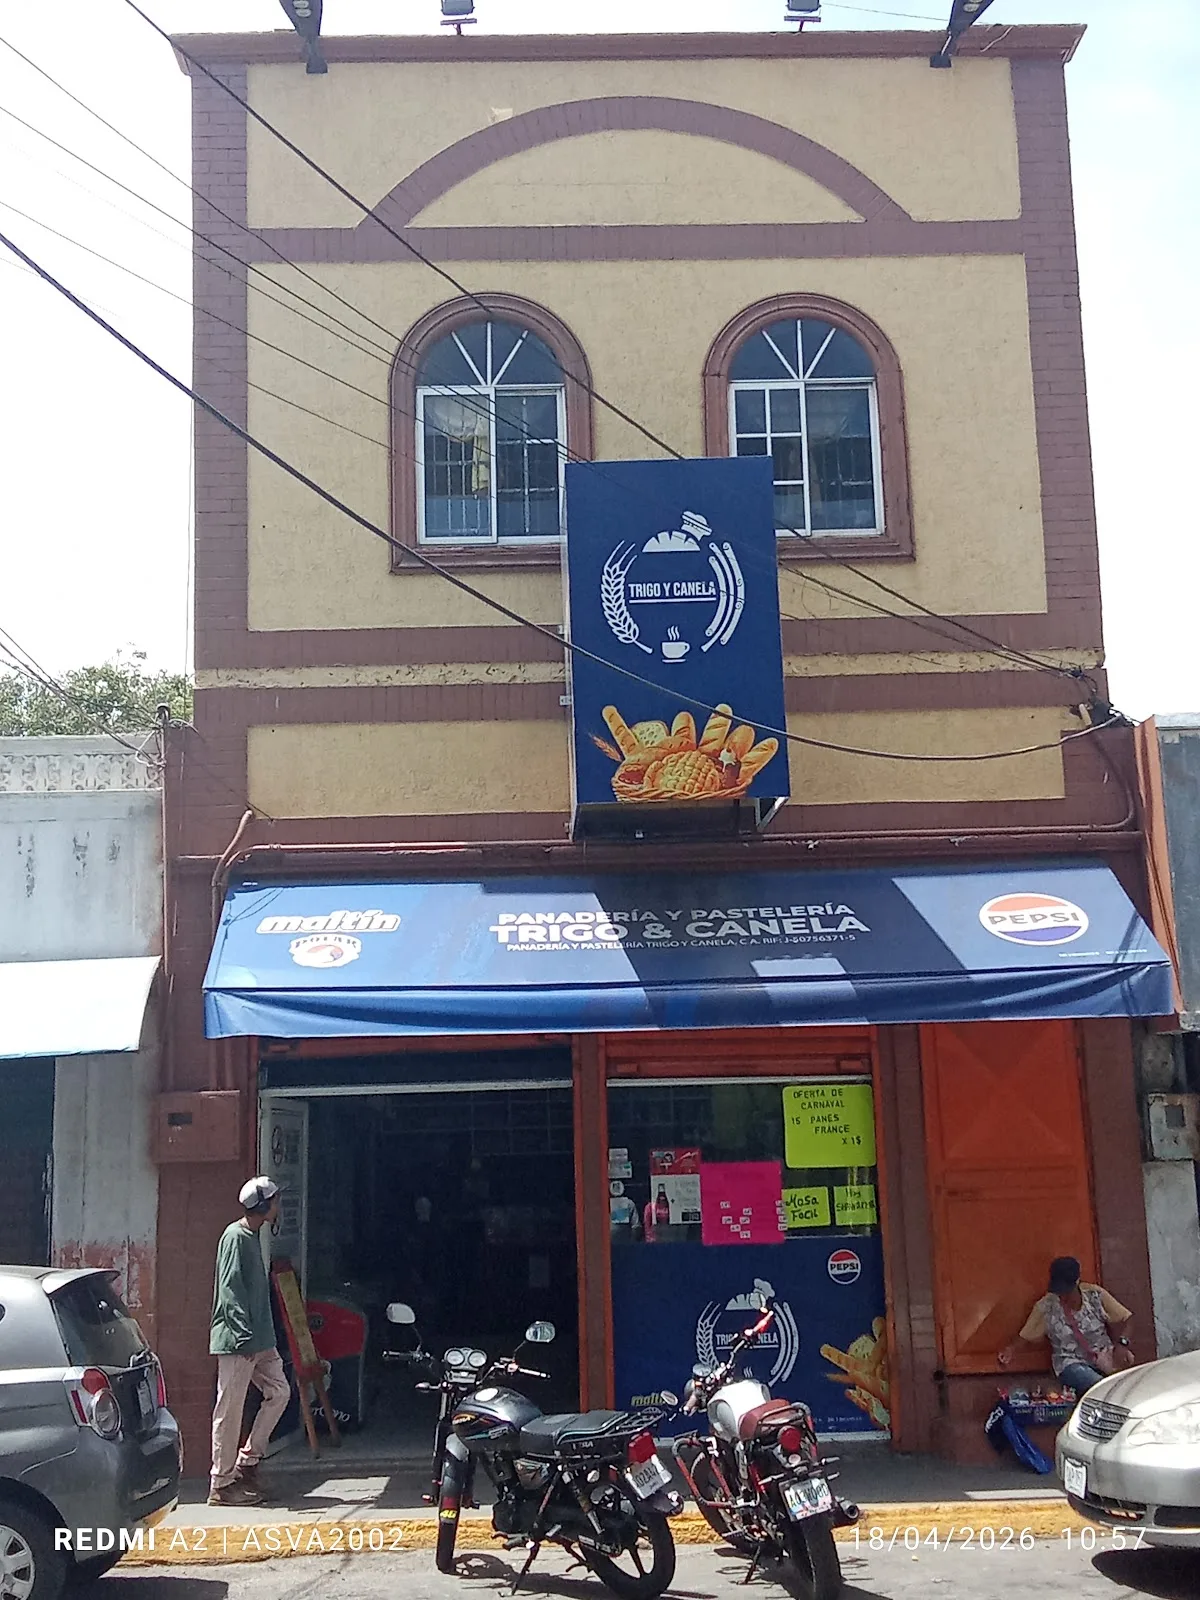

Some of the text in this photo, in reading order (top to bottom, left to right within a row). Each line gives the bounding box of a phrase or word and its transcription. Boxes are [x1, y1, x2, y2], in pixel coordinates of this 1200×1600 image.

[628, 581, 717, 598] TRIGO Y CANELA
[498, 902, 856, 925] PANADERÍA Y PASTELERÍA
[988, 912, 1080, 925] PEPSI
[489, 916, 871, 943] TRIGO & CANELA
[507, 942, 570, 951] PANADERÍA
[793, 1088, 844, 1099] OFERTA DE
[800, 1100, 845, 1110] CARNAVAL
[791, 1113, 840, 1125] 15 PANES
[814, 1124, 850, 1135] FRANCE
[830, 1262, 859, 1271] PEPSI
